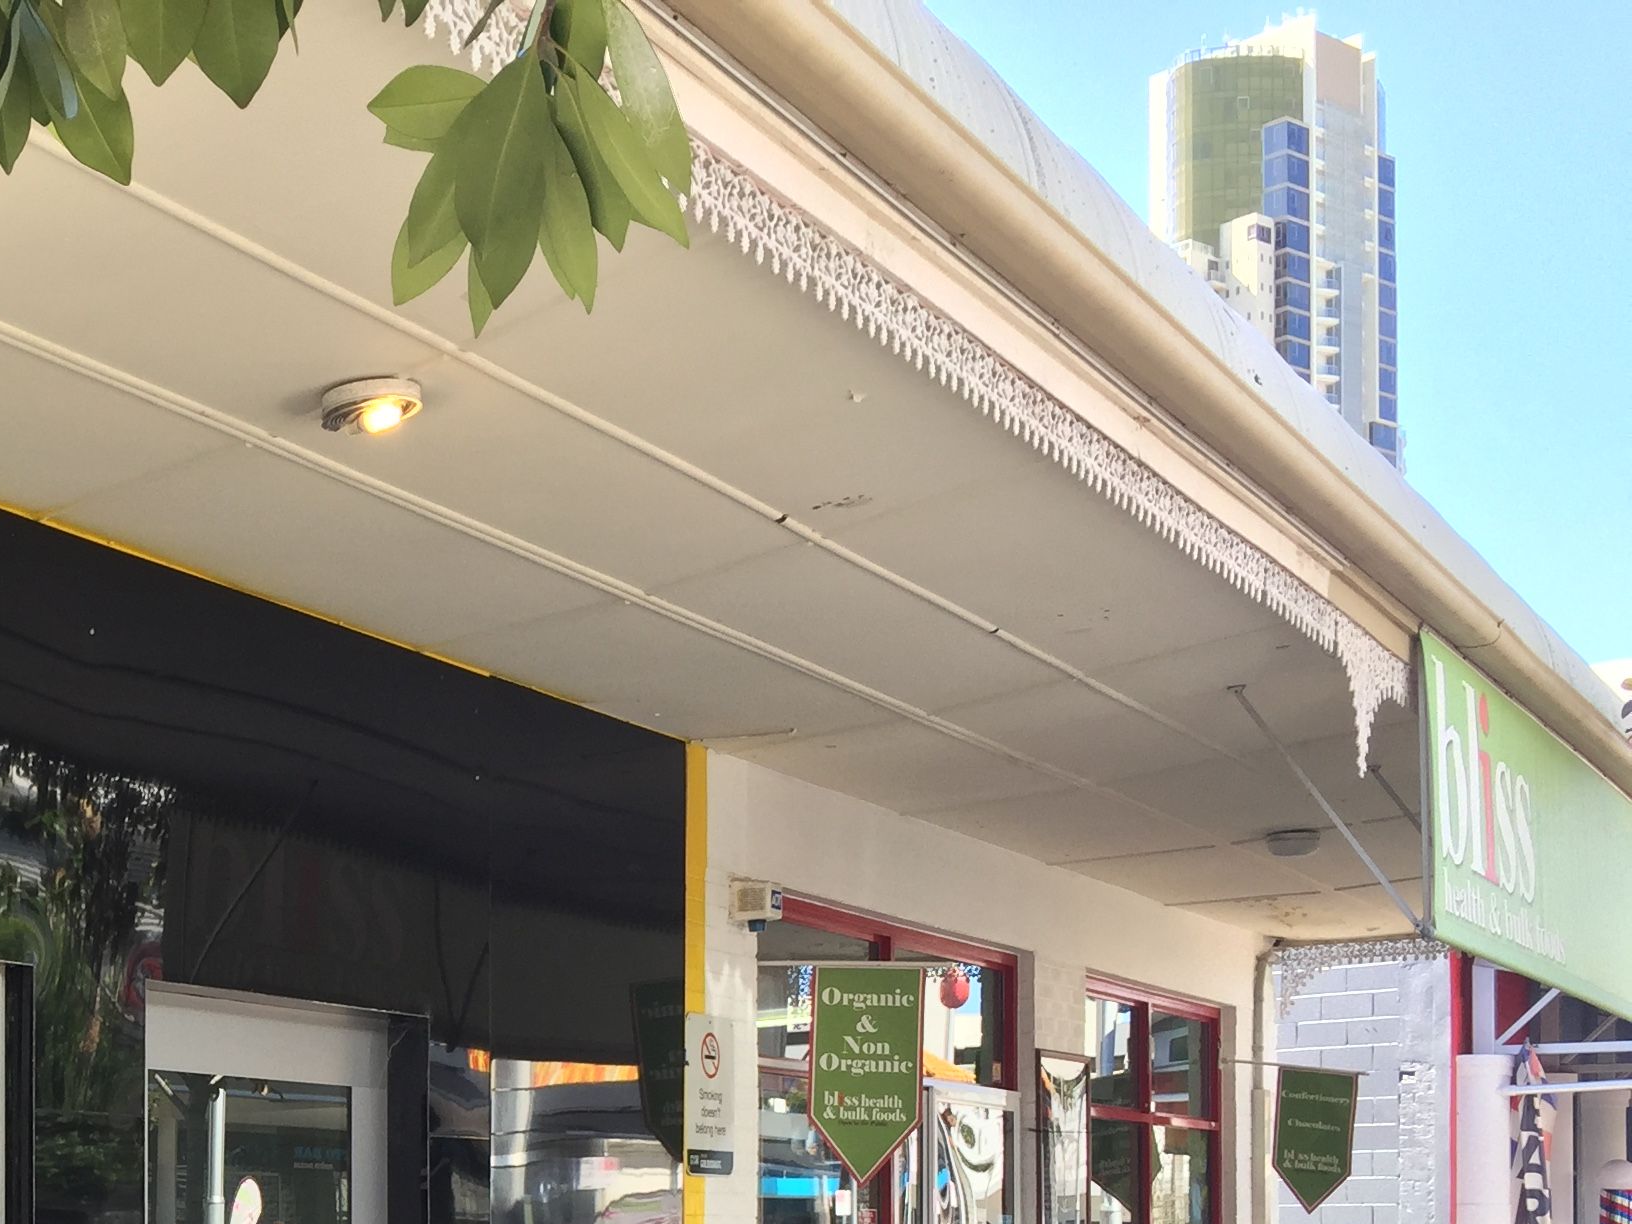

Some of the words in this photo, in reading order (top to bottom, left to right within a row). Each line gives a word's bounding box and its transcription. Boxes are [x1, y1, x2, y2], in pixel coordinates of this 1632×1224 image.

[1431, 654, 1536, 904] bliss
[1443, 866, 1486, 929] health
[1489, 892, 1502, 936] &
[822, 987, 915, 1011] Organic
[856, 1014, 879, 1033] &
[843, 1035, 891, 1055] Non
[819, 1052, 914, 1077] Organic
[699, 1088, 723, 1105] Smoking
[860, 1094, 903, 1109] health
[823, 1106, 836, 1120] &
[839, 1107, 869, 1121] bulk
[872, 1108, 907, 1122] foods
[1284, 1149, 1308, 1160] blss
